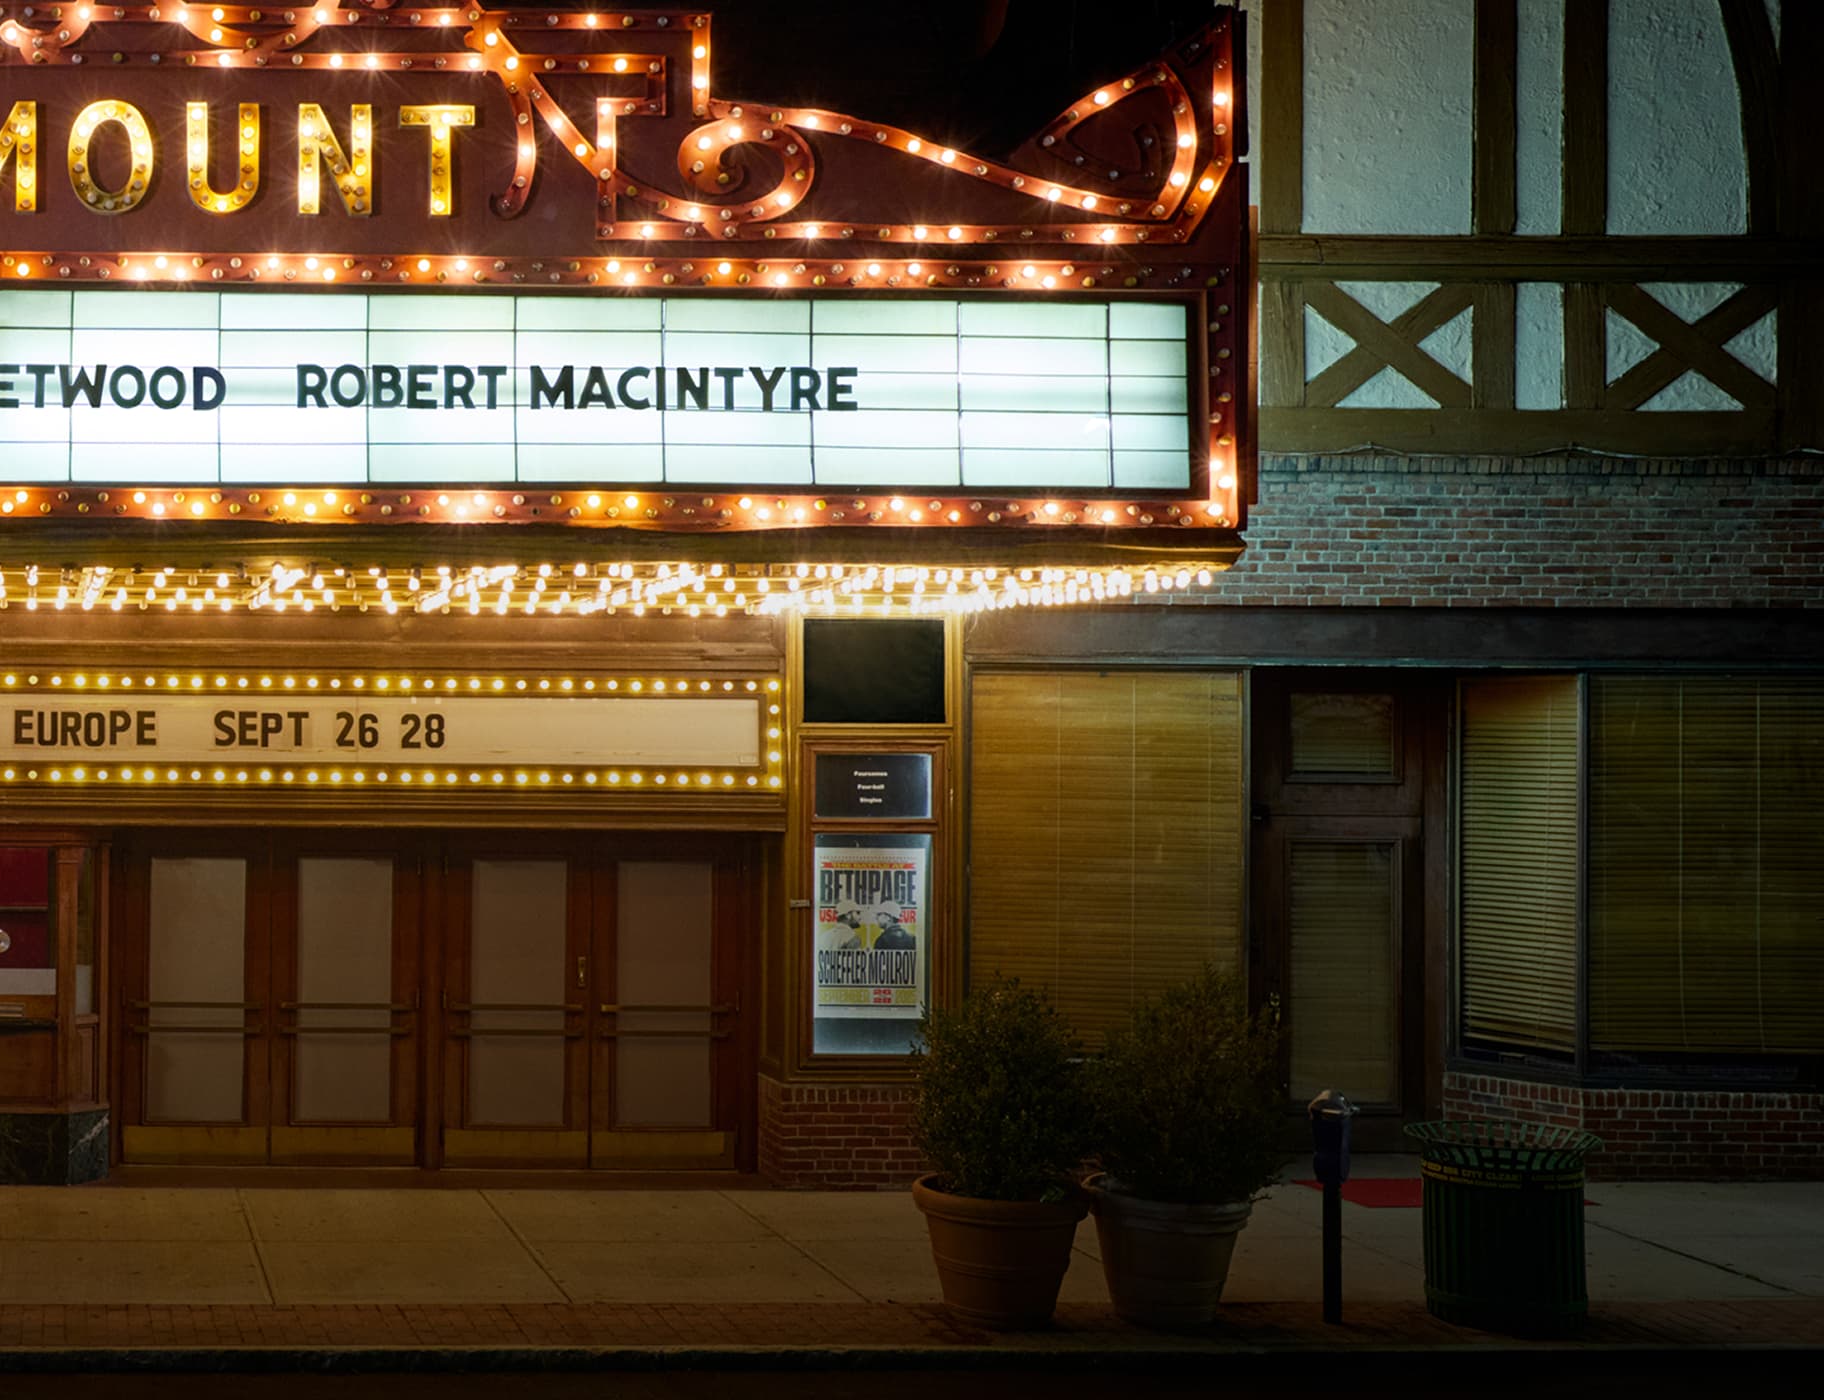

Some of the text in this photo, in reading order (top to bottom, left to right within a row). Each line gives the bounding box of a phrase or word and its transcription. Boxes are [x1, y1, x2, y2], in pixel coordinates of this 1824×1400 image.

[297, 365, 507, 409] ROBERT
[531, 366, 858, 411] MACINTYRE
[14, 710, 157, 747] EUROPE
[214, 711, 309, 747] SEPT
[335, 711, 379, 748] 26
[401, 713, 445, 749] 28
[820, 870, 916, 905] BETHPAGE
[818, 951, 916, 985] SCHEFFLER MCILROY
